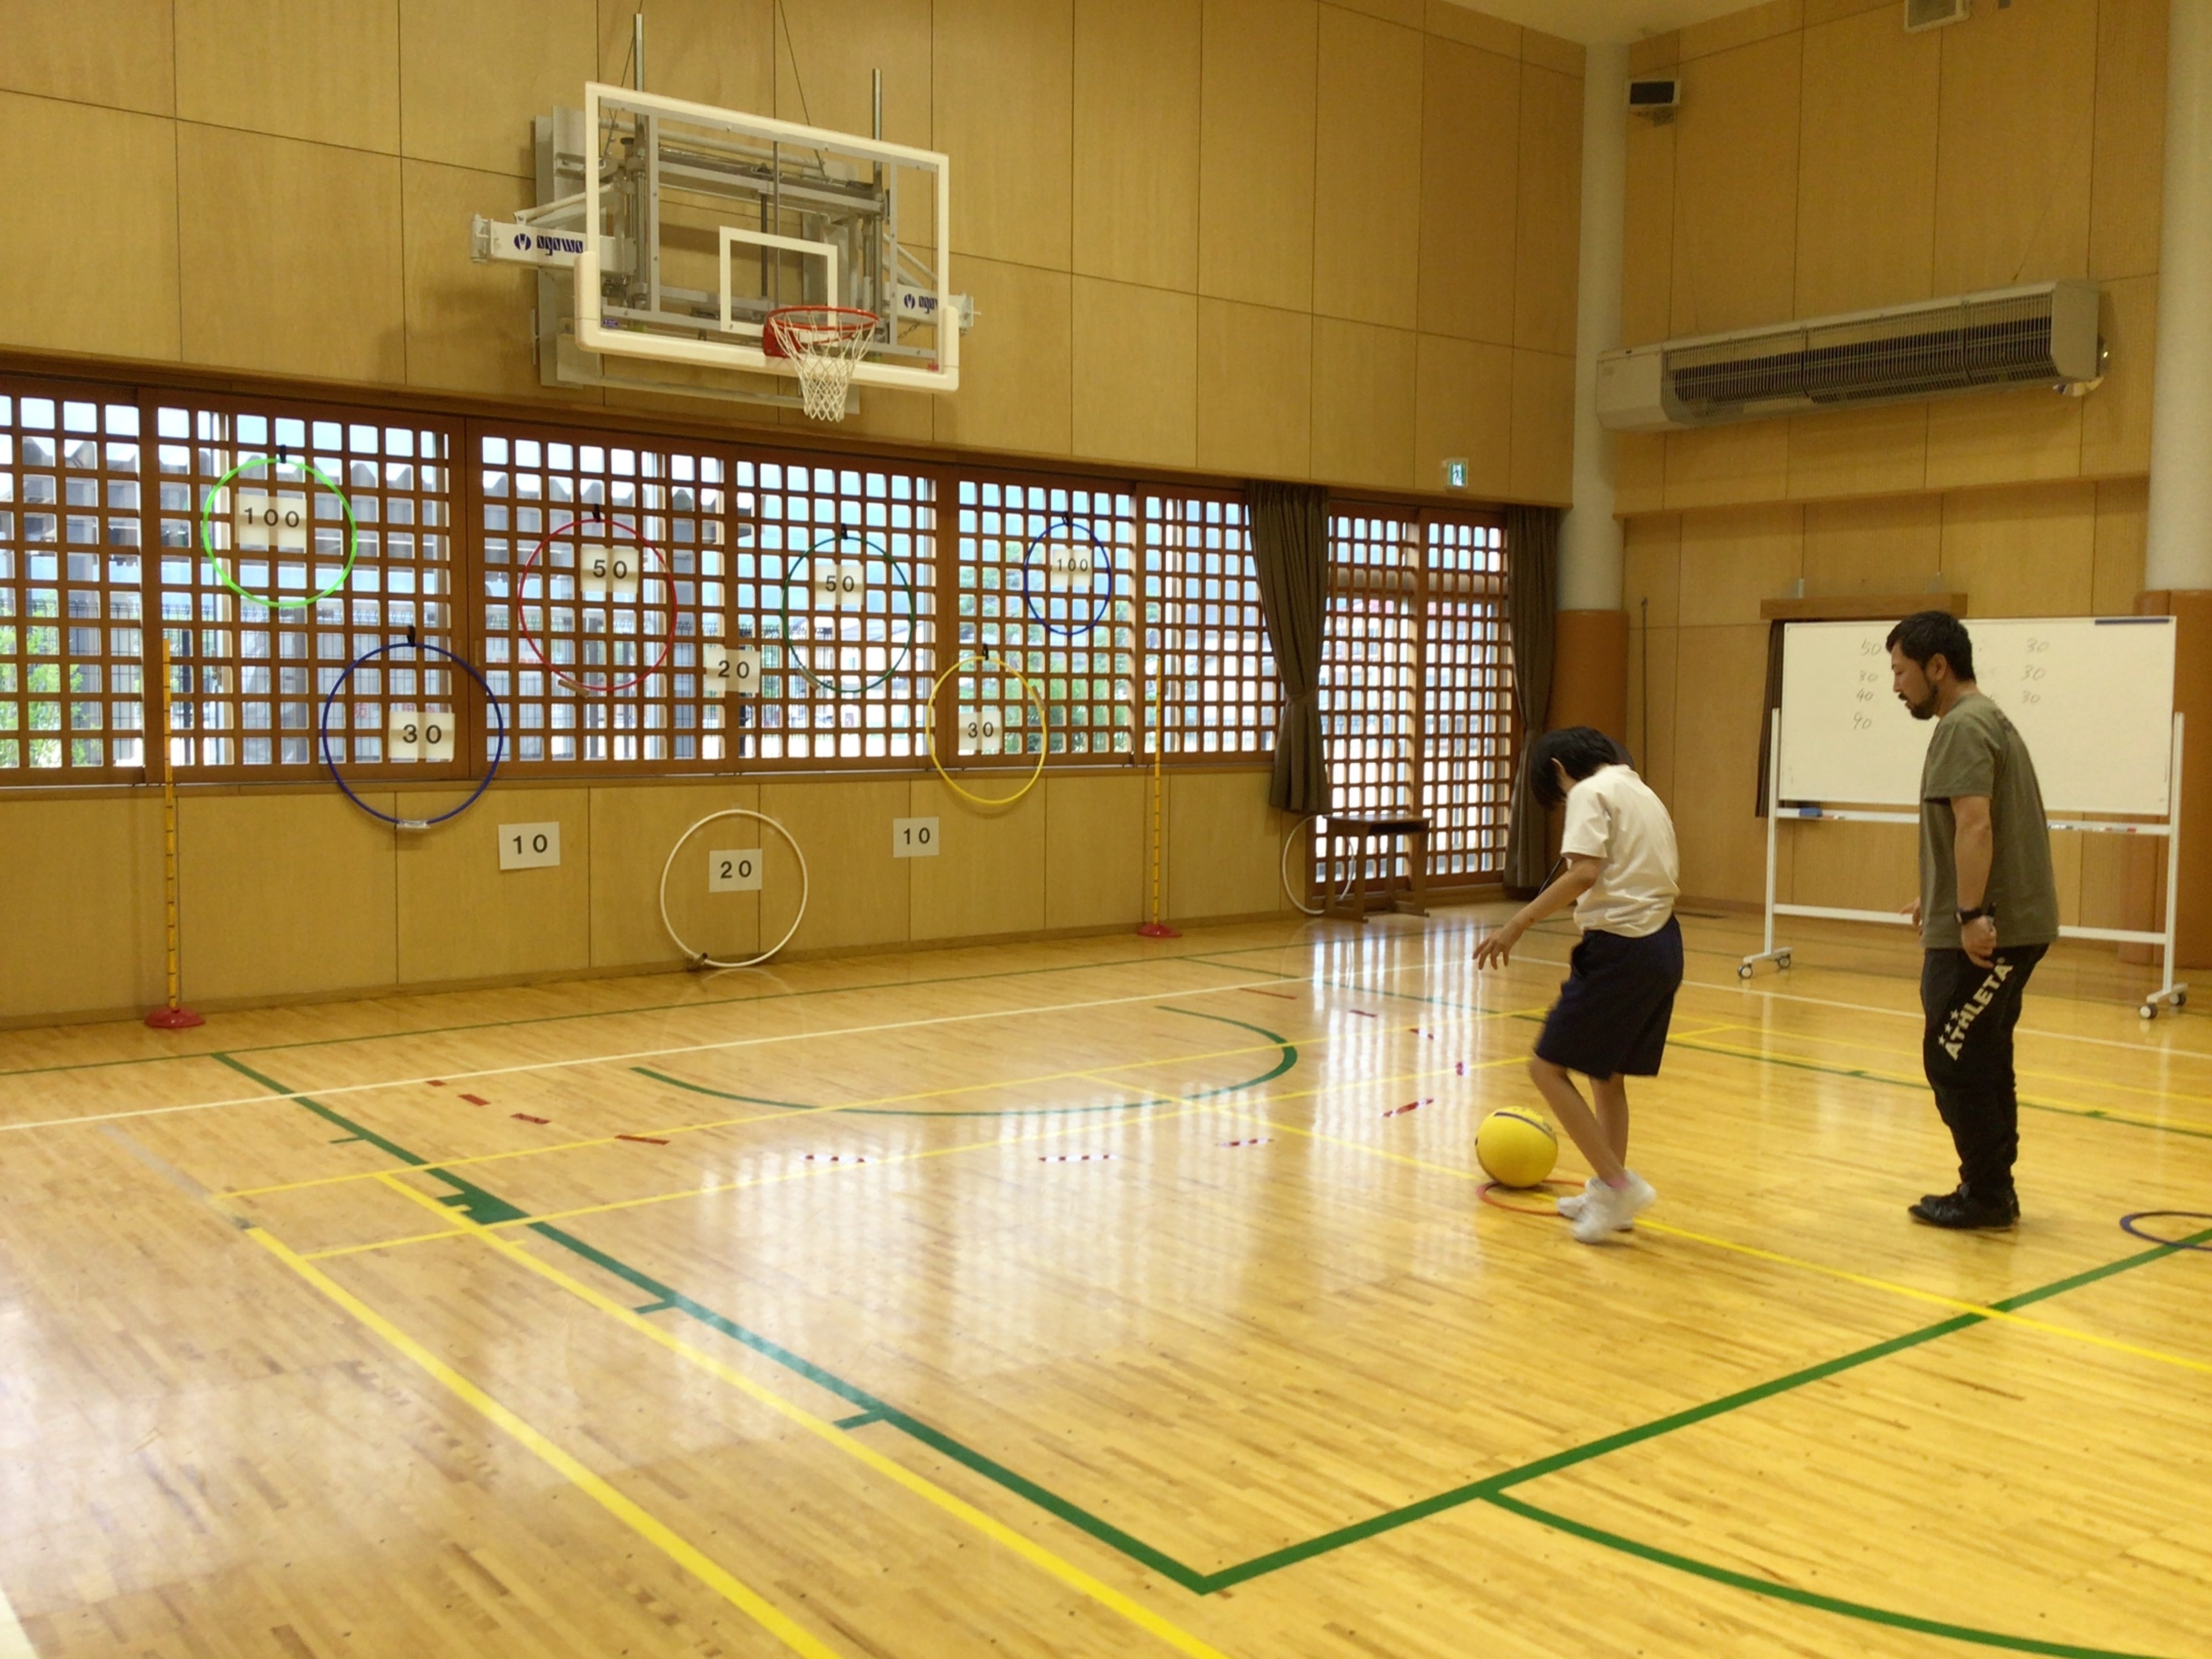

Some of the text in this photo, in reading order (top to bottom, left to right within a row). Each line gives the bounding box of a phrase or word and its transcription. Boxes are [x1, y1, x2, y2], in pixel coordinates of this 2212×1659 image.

[243, 507, 301, 529] 100
[592, 559, 628, 580] 50
[1056, 556, 1089, 574] 100
[825, 575, 856, 594] 50
[717, 659, 750, 680] 20
[1856, 689, 1874, 702] 40
[402, 724, 443, 745] 30
[967, 721, 995, 739] 30
[512, 834, 548, 855] 10
[903, 827, 931, 846] 10
[720, 859, 752, 880] 20
[1944, 962, 2014, 1061] ATHLETA
